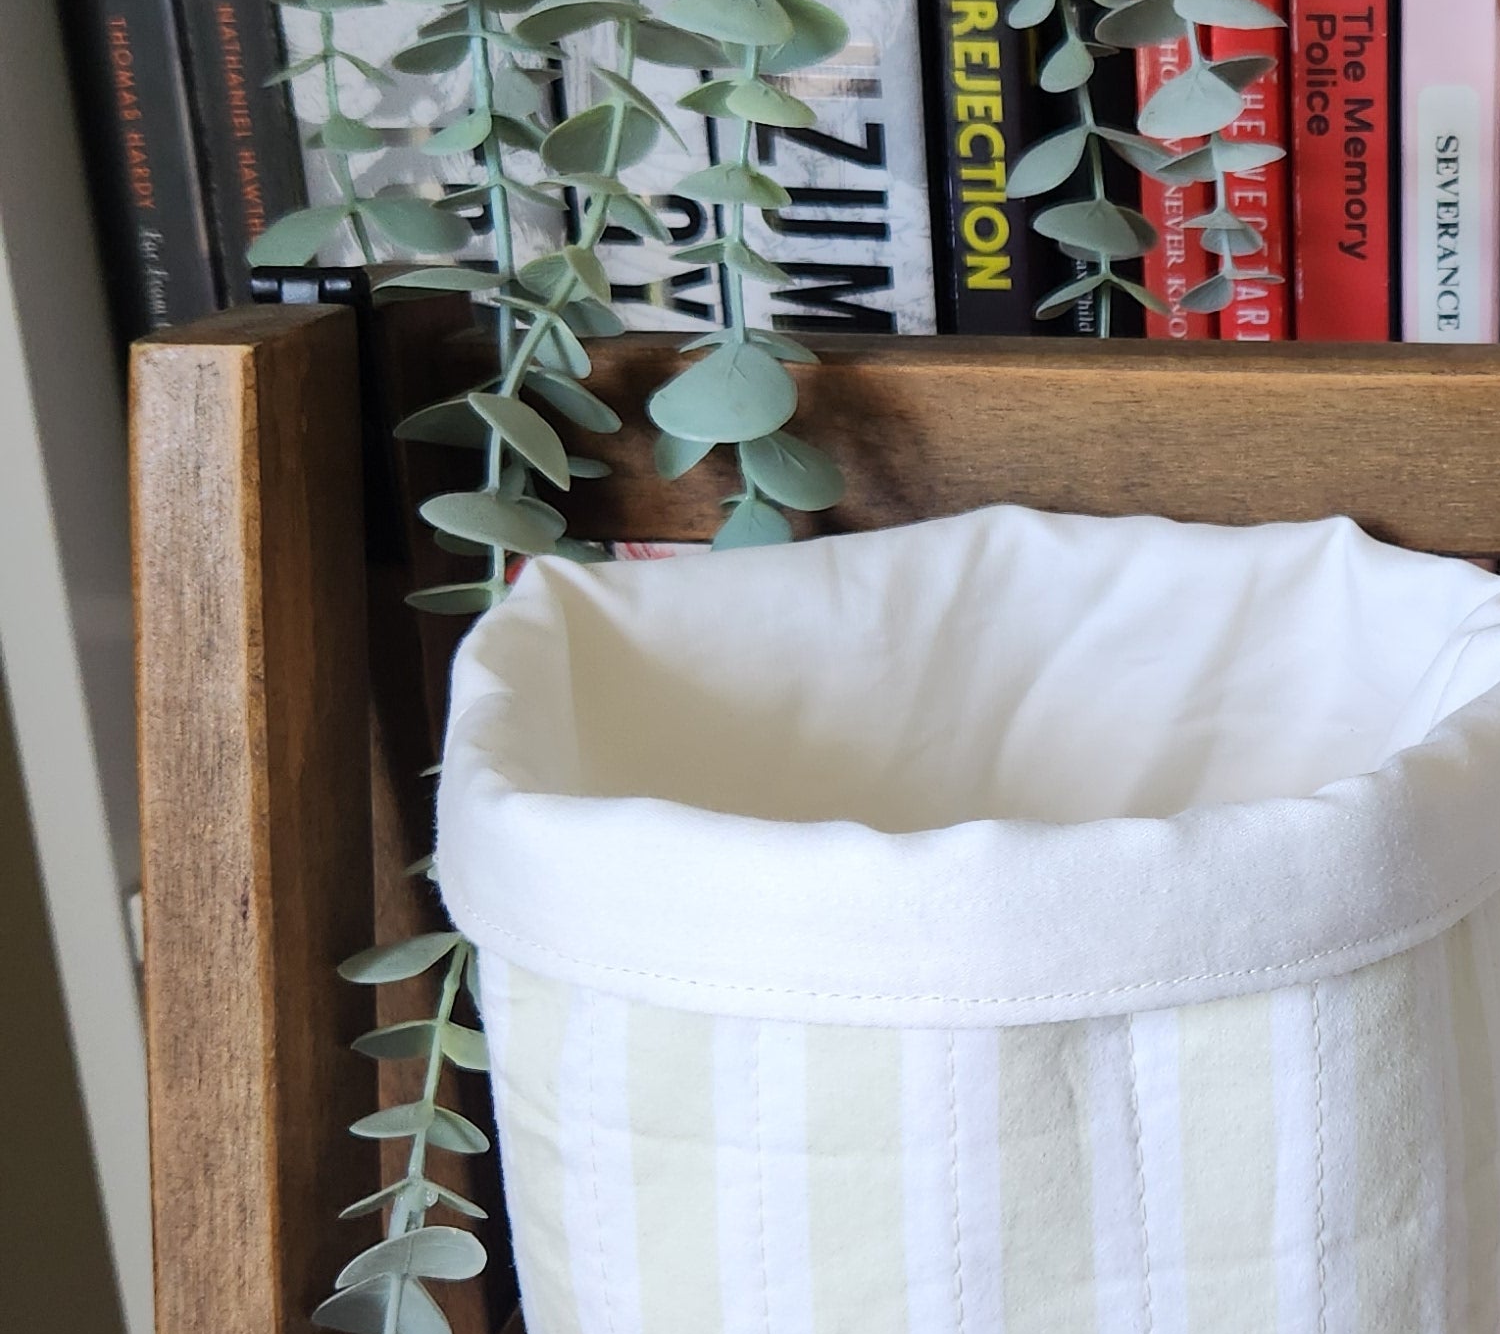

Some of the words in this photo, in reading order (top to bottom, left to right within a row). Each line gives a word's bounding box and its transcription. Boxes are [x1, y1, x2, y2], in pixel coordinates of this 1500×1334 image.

[1305, 13, 1338, 138] Police
[1341, 6, 1376, 71] The
[124, 133, 158, 211] HARDY
[1338, 94, 1376, 261] Memory
[1163, 183, 1188, 268] NEVER
[1435, 134, 1460, 332] SEVERANCE
[1168, 276, 1189, 339] KNO
